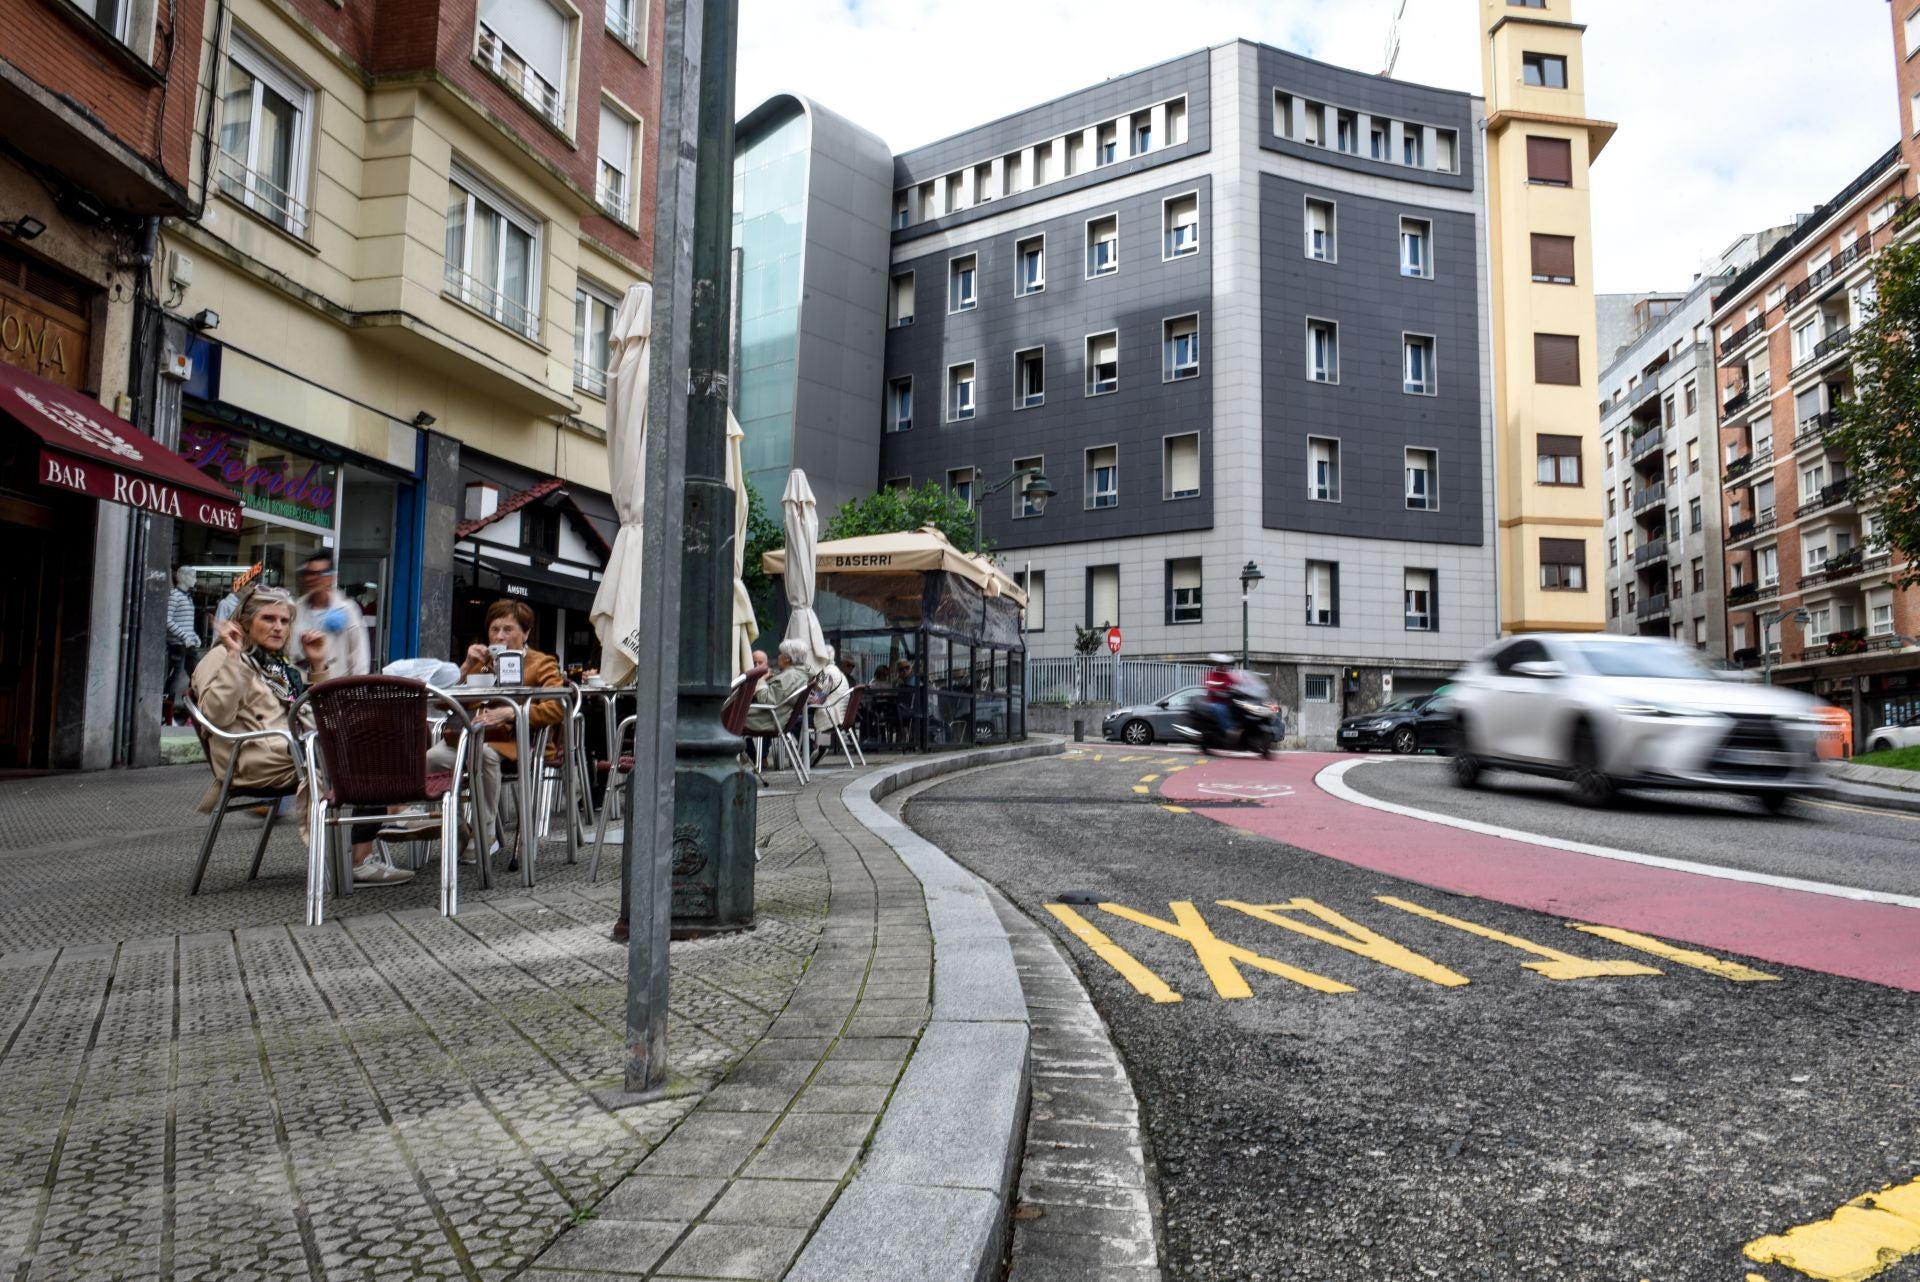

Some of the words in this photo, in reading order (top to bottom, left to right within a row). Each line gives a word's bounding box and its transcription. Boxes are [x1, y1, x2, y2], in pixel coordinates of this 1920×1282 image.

[46, 460, 86, 491] BAR
[113, 473, 183, 518] ROMA
[199, 503, 239, 530] CAFÉ
[836, 554, 892, 567] BASERRI
[232, 560, 263, 593] OFERTAS
[507, 583, 528, 597] AMSTEL
